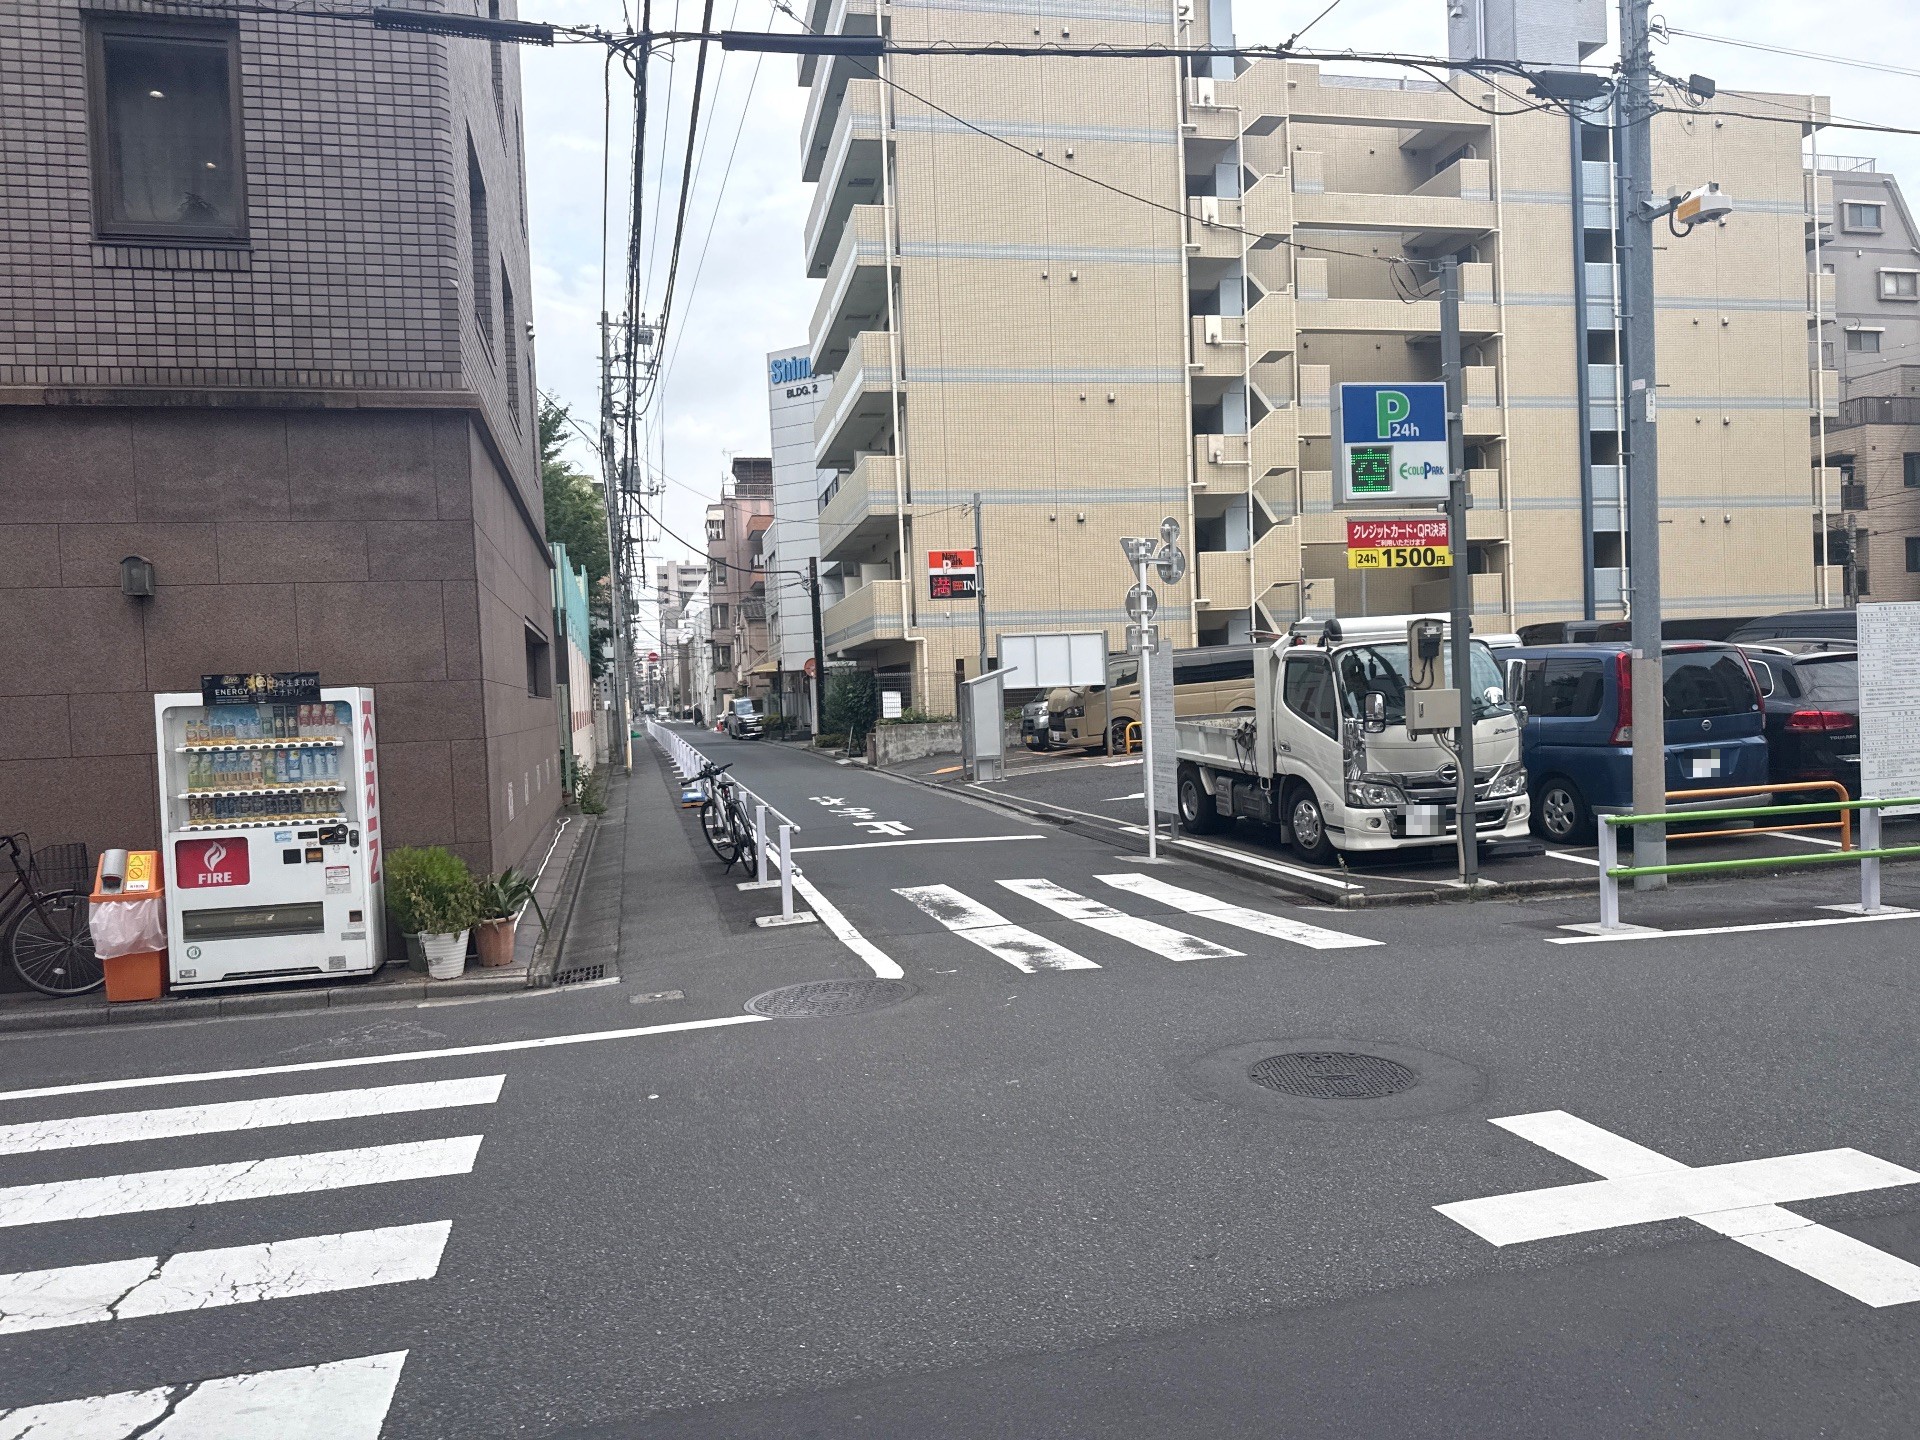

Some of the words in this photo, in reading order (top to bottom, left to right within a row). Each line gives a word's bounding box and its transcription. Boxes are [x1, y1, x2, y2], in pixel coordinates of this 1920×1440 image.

[770, 356, 813, 385] Shim
[786, 386, 810, 398] BLDG.
[812, 384, 818, 394] 2
[1375, 390, 1411, 439] P
[1392, 423, 1420, 437] 24h
[1351, 448, 1390, 493] 空
[1357, 551, 1377, 564] 24h
[942, 558, 963, 574] Park
[963, 580, 975, 591] IN
[214, 688, 249, 696] ENERGY
[361, 700, 381, 884] KIRIN
[198, 872, 233, 885] FIRE
